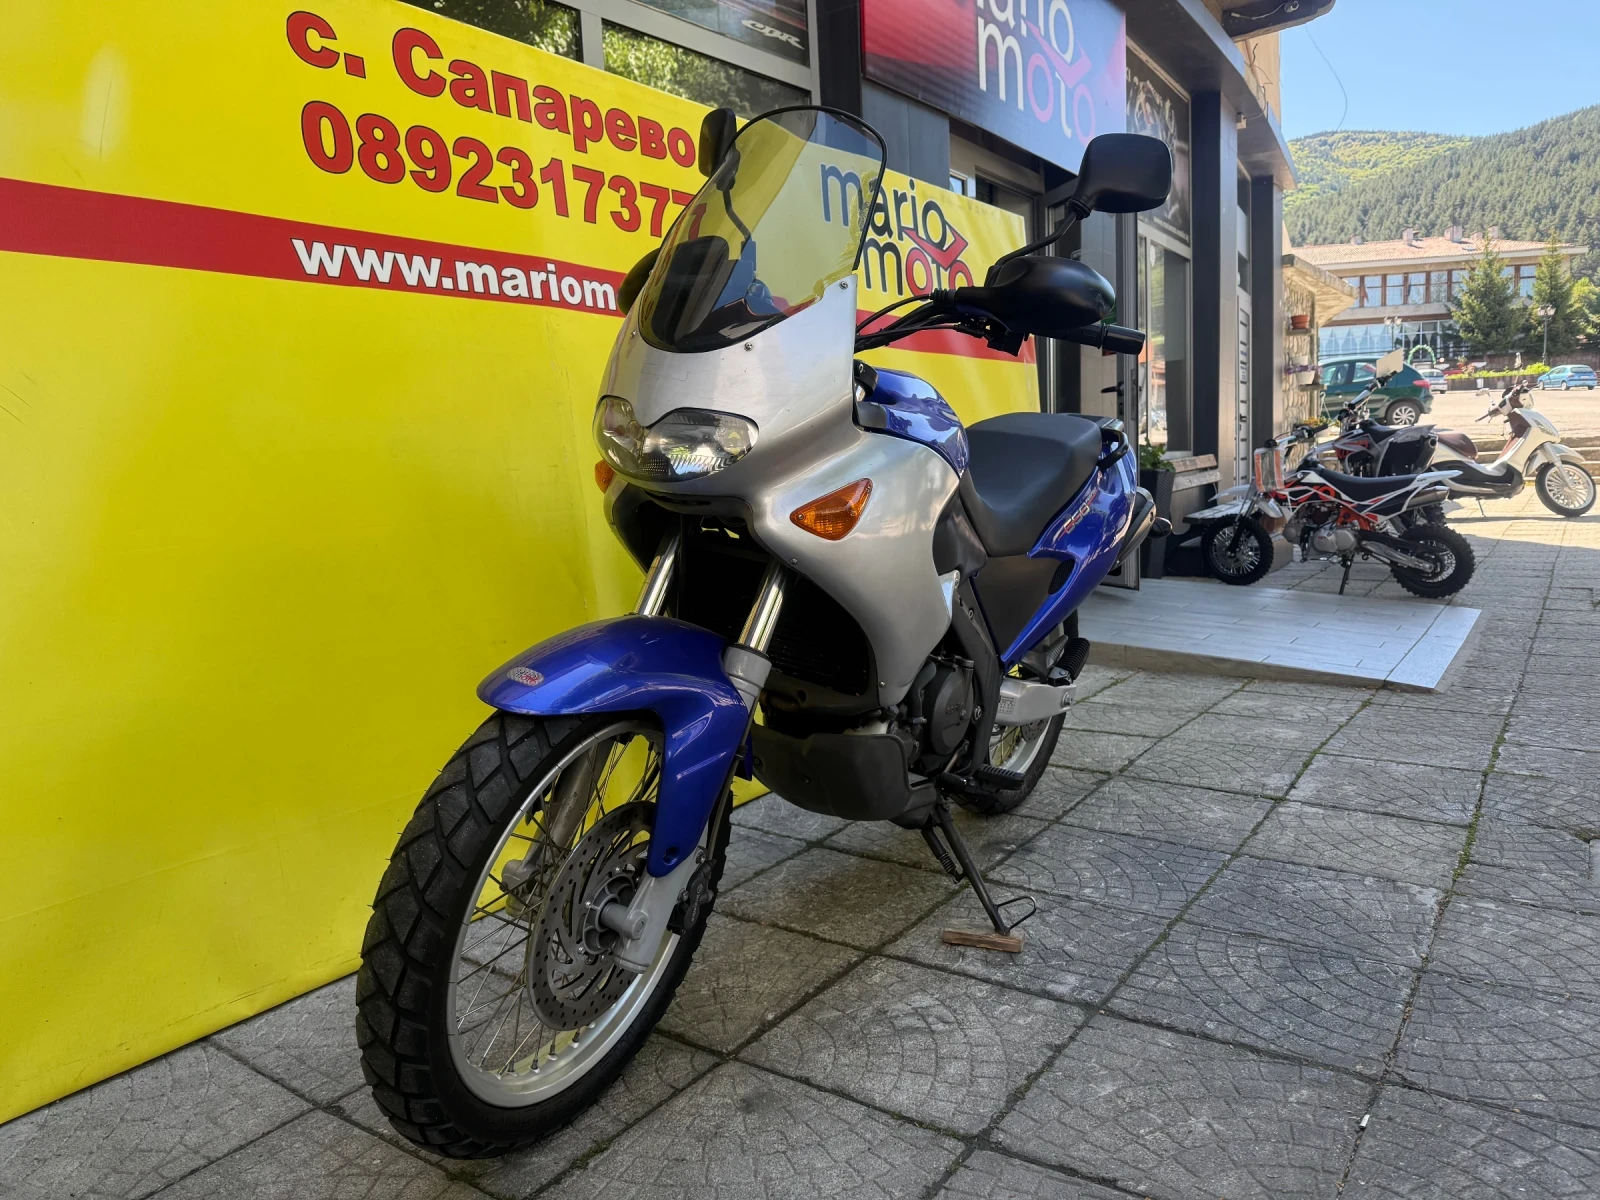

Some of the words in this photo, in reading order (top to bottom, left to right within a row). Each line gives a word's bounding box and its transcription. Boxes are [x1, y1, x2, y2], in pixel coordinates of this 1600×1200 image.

[286, 11, 367, 80] с.
[392, 28, 697, 168] Сапарево
[977, 16, 1097, 149] moto
[820, 163, 948, 252] mario
[291, 238, 618, 312] www.mariom
[862, 237, 975, 302] moto
